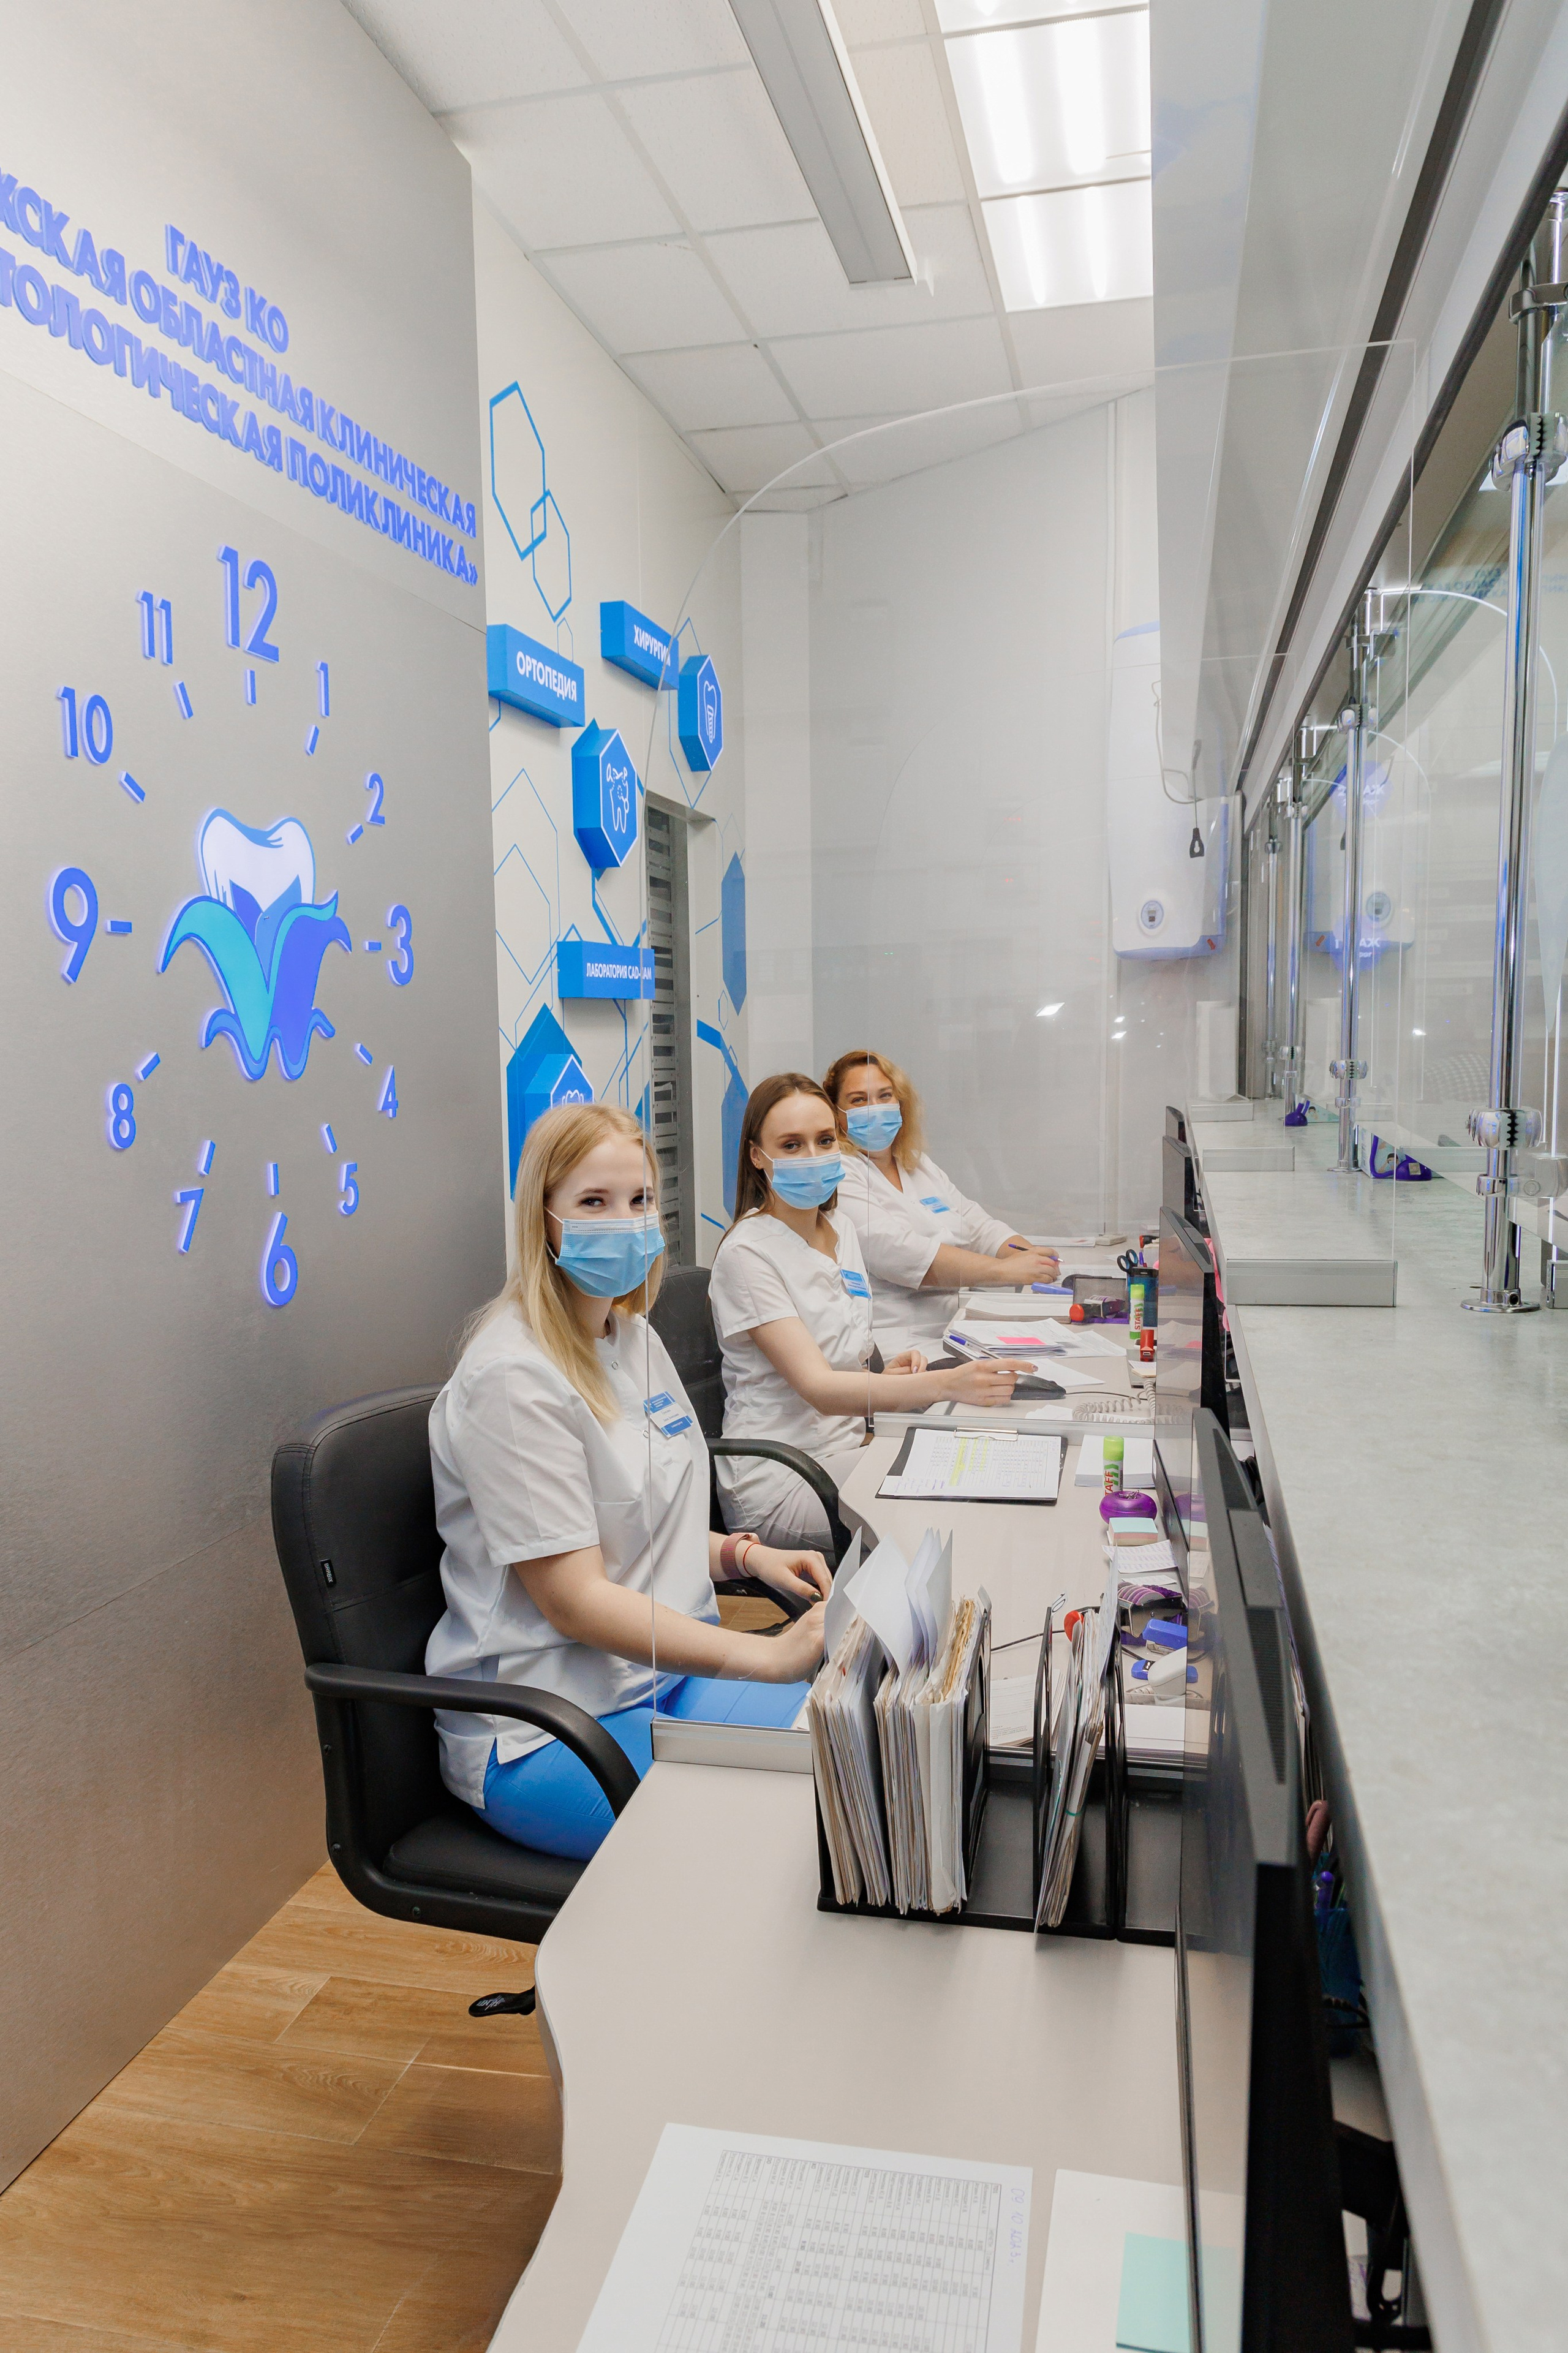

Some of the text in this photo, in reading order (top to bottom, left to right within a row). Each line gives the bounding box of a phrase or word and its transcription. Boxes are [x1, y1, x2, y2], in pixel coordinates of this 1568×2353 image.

[165, 224, 289, 353] ГАУЗ КО
[129, 270, 315, 432] ОБЛАСТНАЯ
[316, 398, 477, 538] КЛИНИЧЕСКАЯ
[286, 436, 478, 586] ПОЛИКЛИНИКА»
[135, 589, 173, 665] 11
[217, 544, 280, 663] 12
[316, 660, 330, 717] 1
[516, 651, 577, 703] ОРТОПЕДИЯ
[56, 684, 113, 765] 10
[366, 772, 386, 826] 2
[48, 866, 99, 984] 9
[386, 904, 414, 986] 3
[586, 962, 652, 980] ЛАБОРАТОРИЯ CAD-AM
[108, 1082, 137, 1150] 8
[377, 1065, 399, 1119] 4
[175, 1187, 205, 1253] 7
[339, 1162, 360, 1216] 5
[262, 1210, 299, 1306] 6
[1104, 1470, 1114, 1496] TAFF
[324, 1562, 334, 1583] BRABIX
